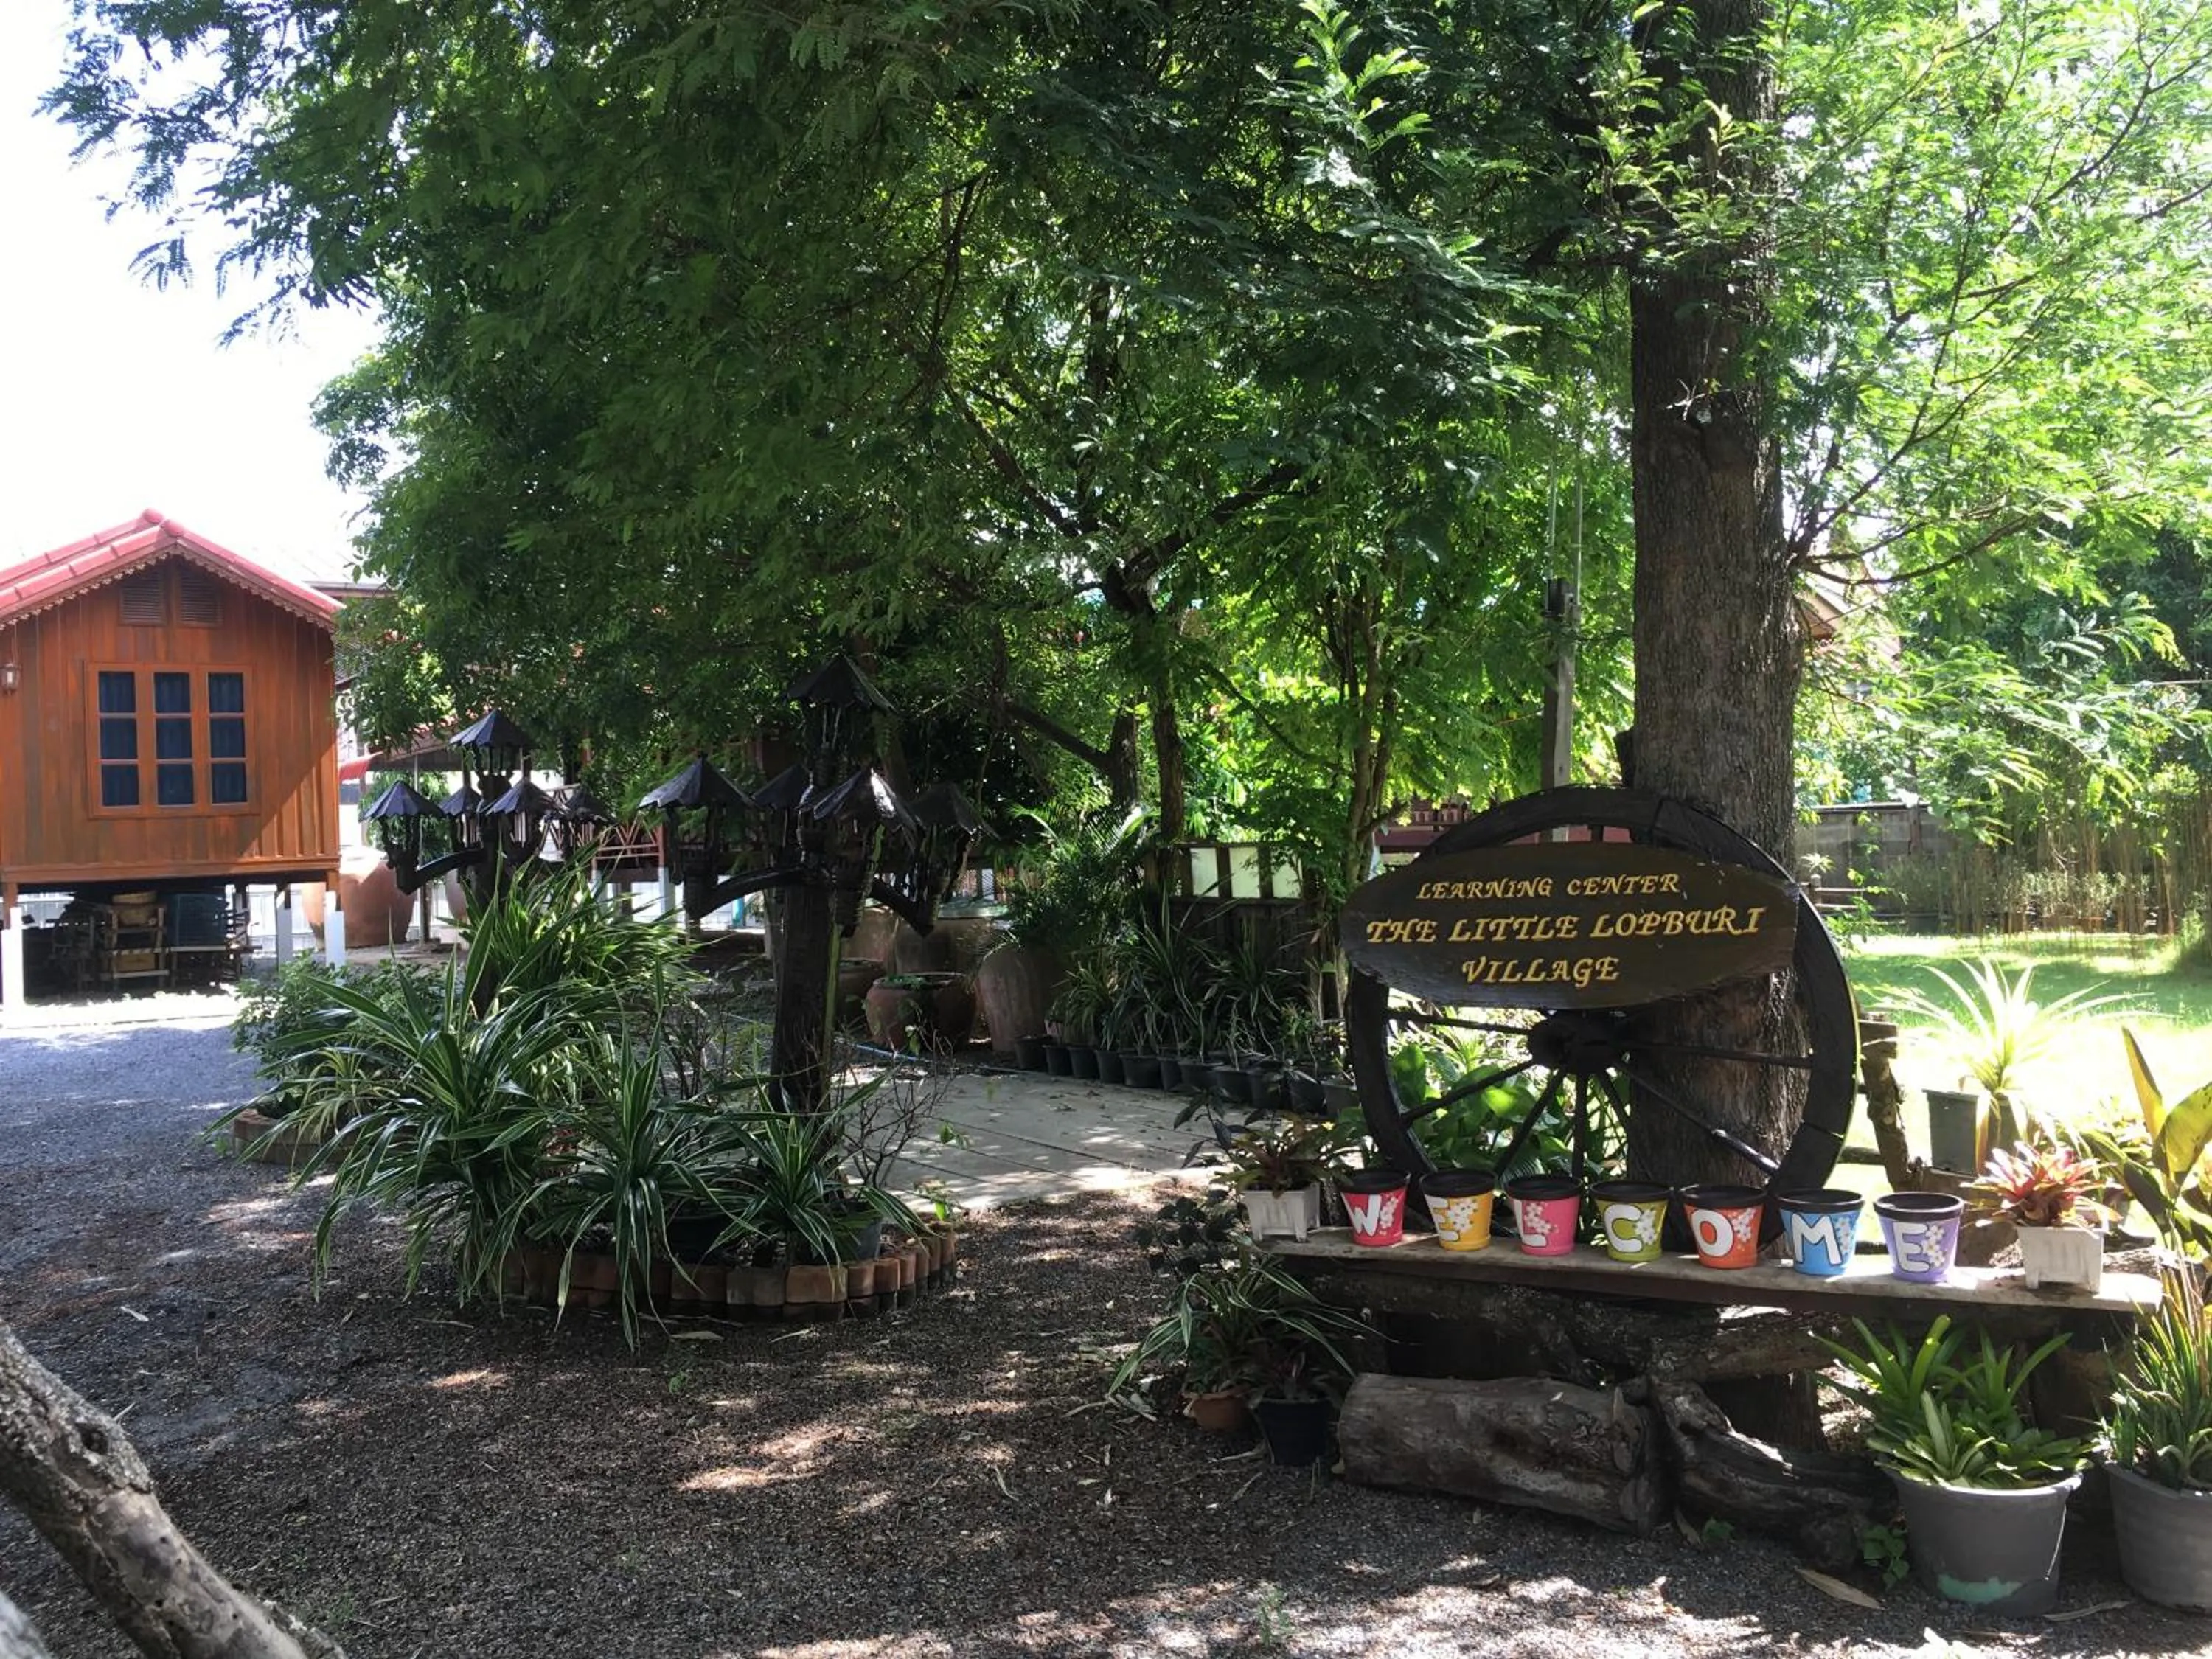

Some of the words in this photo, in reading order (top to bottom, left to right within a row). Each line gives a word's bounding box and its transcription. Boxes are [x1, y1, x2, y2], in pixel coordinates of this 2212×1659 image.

[1416, 877, 1553, 900] LEARNING
[1567, 872, 1681, 897] CENTER
[1366, 919, 1438, 944] THE
[1447, 914, 1579, 942] LITTLE
[1589, 905, 1767, 939] LOPBURI
[1461, 955, 1621, 989] VILLAGE
